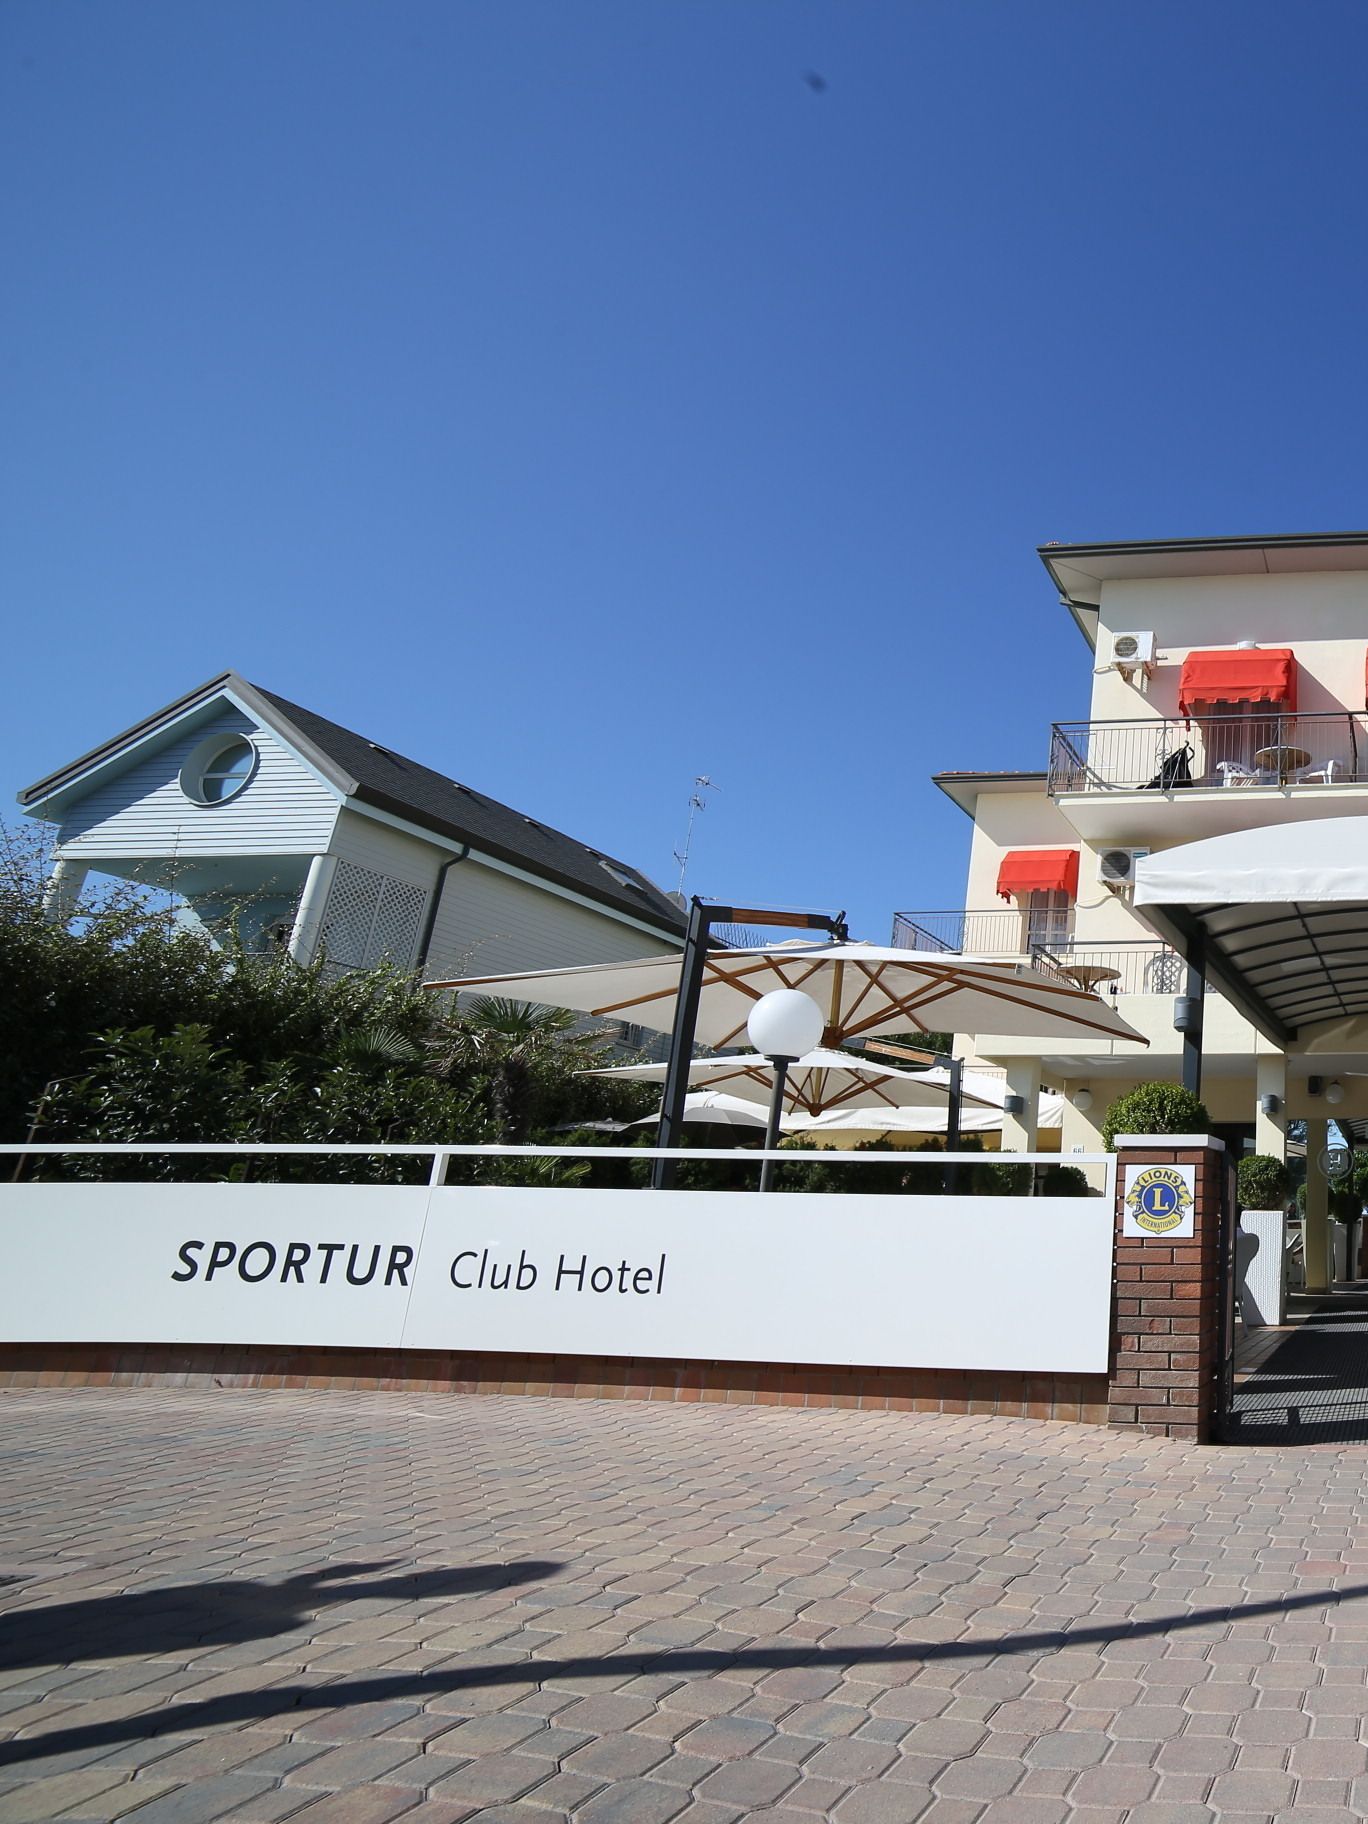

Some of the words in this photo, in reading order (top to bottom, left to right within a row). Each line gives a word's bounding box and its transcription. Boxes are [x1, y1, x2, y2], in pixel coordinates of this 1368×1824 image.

[1141, 1169, 1180, 1185] LIONS
[1139, 1215, 1178, 1229] INTERNATIONAL
[171, 1240, 414, 1287] SPORTUR
[450, 1248, 538, 1291] Club
[555, 1253, 666, 1295] Hotel
